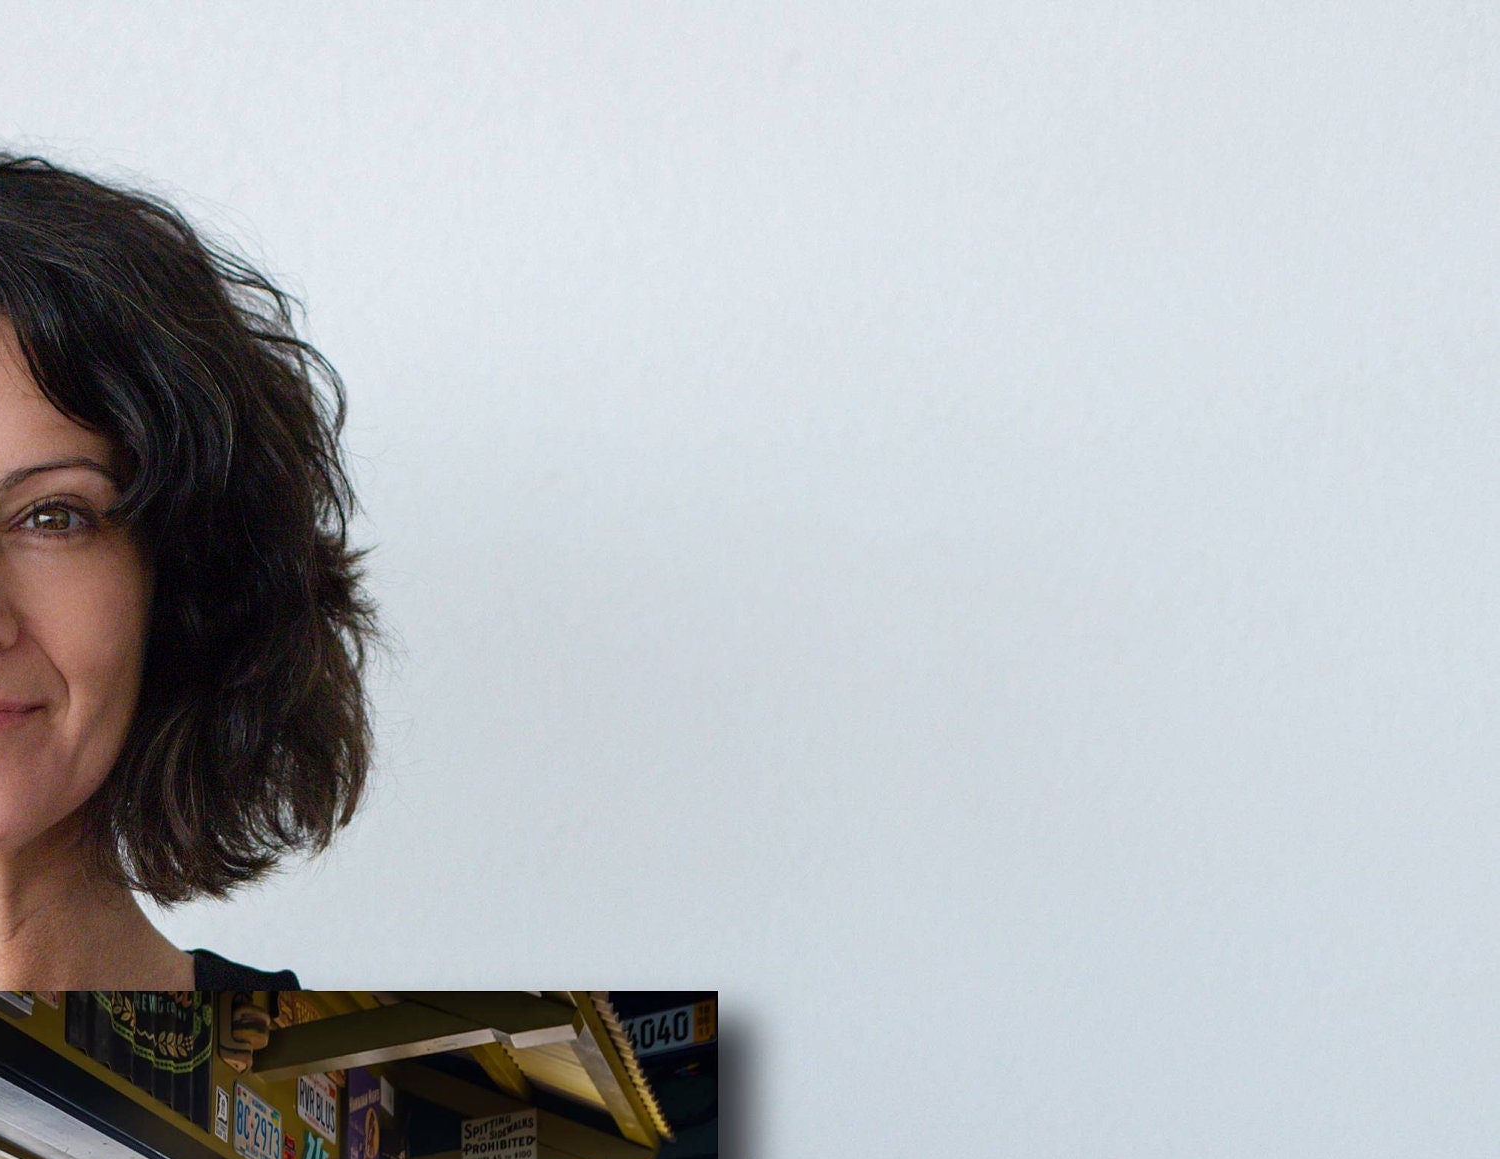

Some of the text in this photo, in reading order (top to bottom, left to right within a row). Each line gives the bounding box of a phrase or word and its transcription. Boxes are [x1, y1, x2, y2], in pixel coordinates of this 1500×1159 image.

[464, 1115, 511, 1140] SPITTING
[490, 1117, 534, 1140] SIDEWALKS
[464, 1136, 534, 1156] PROHIBITED
